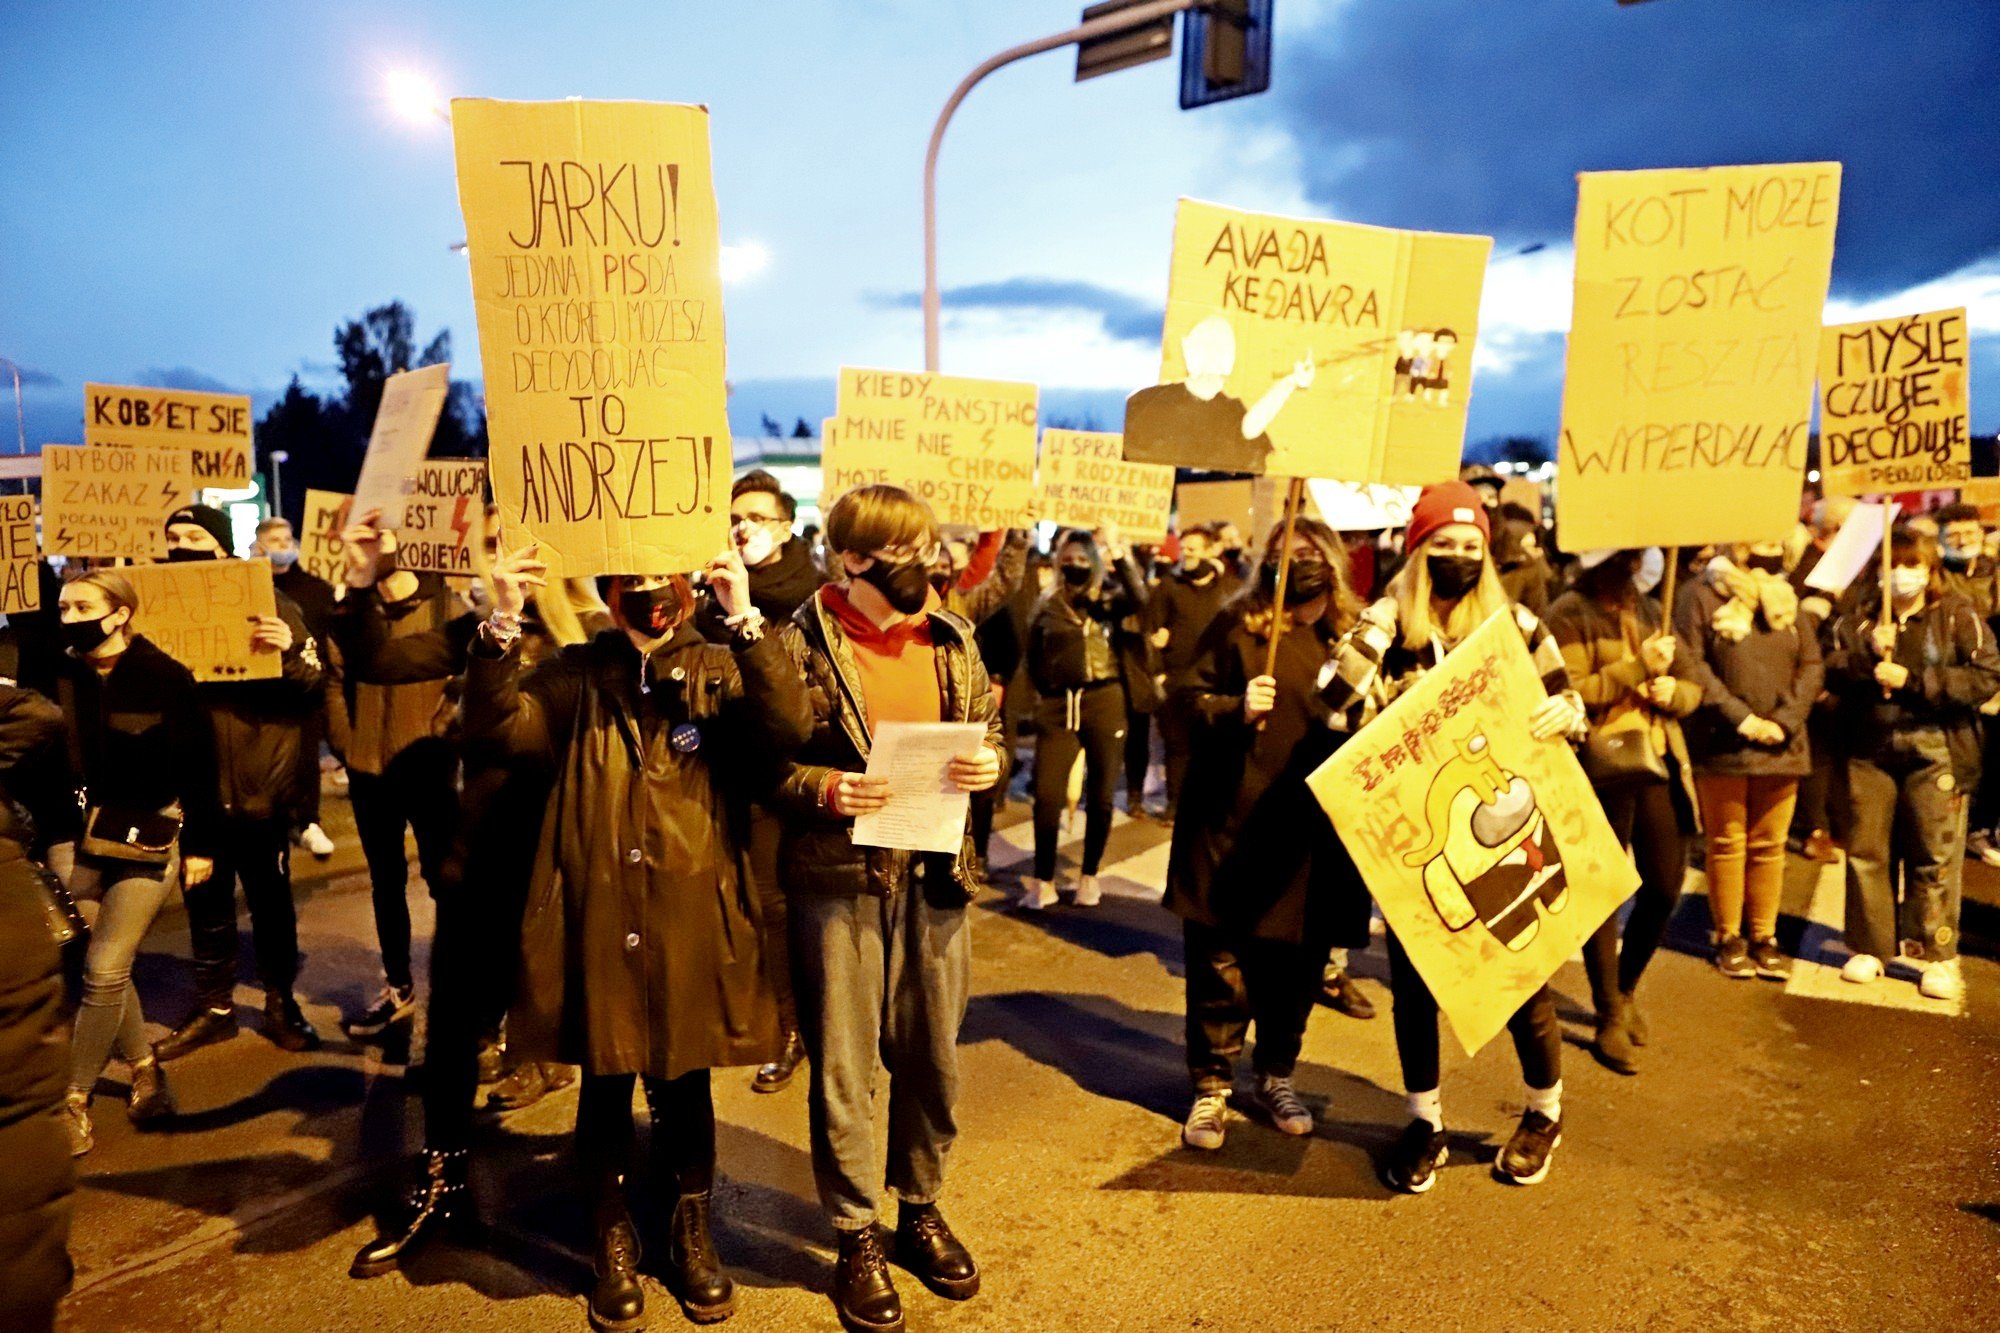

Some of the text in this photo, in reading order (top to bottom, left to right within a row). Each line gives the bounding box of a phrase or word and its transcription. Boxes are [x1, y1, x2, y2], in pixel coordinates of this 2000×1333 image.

[499, 160, 681, 249] JARKU!
[1603, 188, 1707, 250] KOT
[1204, 221, 1329, 276] AVADA
[495, 254, 677, 297] JEDYNA PISDA
[1614, 256, 1794, 318] ZOSTAĆ
[1222, 271, 1380, 328] KEDAVRA
[515, 303, 531, 345] O
[539, 297, 617, 344] KTÓREJ
[1616, 332, 1804, 397] RESZTA
[855, 373, 933, 399] KIEDY
[569, 394, 626, 437] TO
[844, 416, 953, 457] MNIE NIE
[146, 453, 181, 474] NIE
[1071, 436, 1119, 459] SPRA
[416, 467, 485, 497] WOLUCJA
[521, 436, 713, 523] ANDRZEJ!
[947, 456, 1034, 482] CHRONI
[61, 480, 150, 507] ZAKAZ
[904, 478, 994, 505] SIOSTRY
[402, 504, 438, 531] EST
[309, 532, 345, 555] TO
